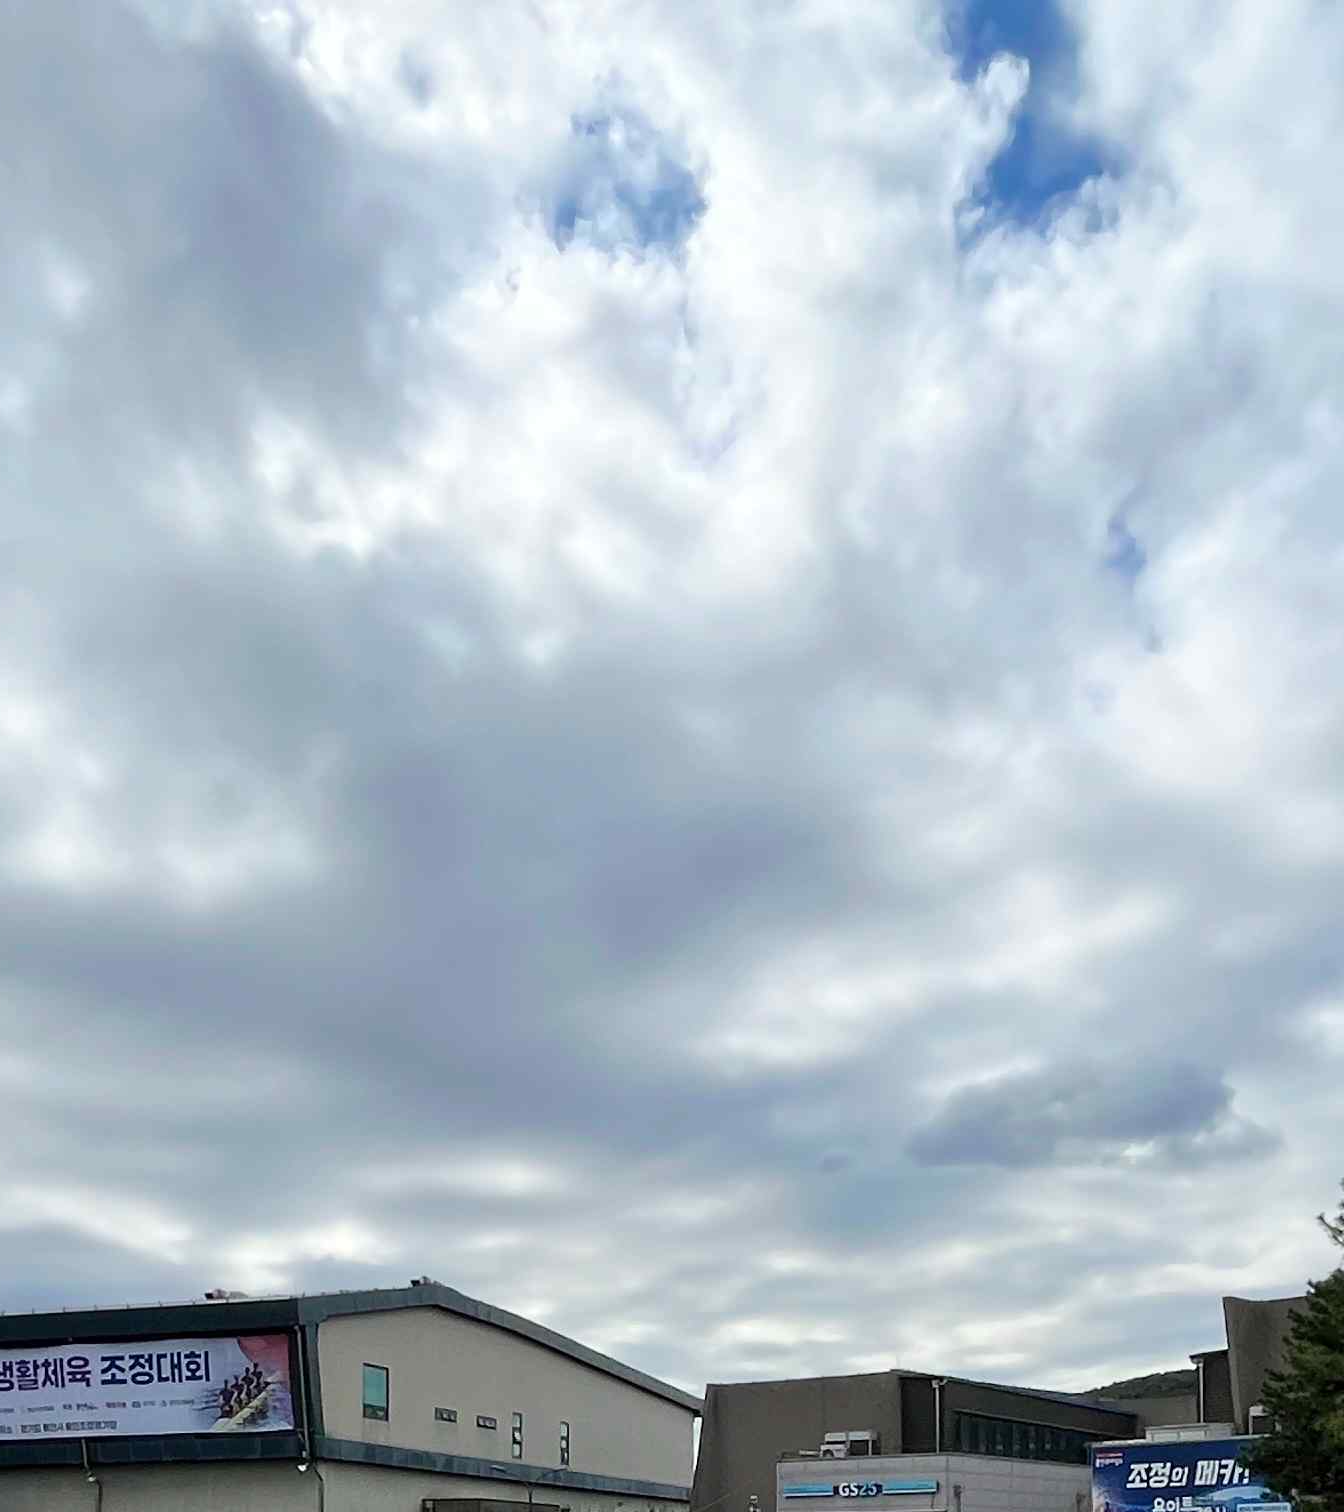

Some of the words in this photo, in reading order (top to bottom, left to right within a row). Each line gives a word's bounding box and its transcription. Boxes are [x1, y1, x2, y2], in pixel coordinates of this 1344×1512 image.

[100, 1350, 211, 1386] 조정대회
[1126, 1461, 1188, 1489] 조정의
[1194, 1459, 1250, 1485] 메카!
[838, 1481, 878, 1498] GS25
